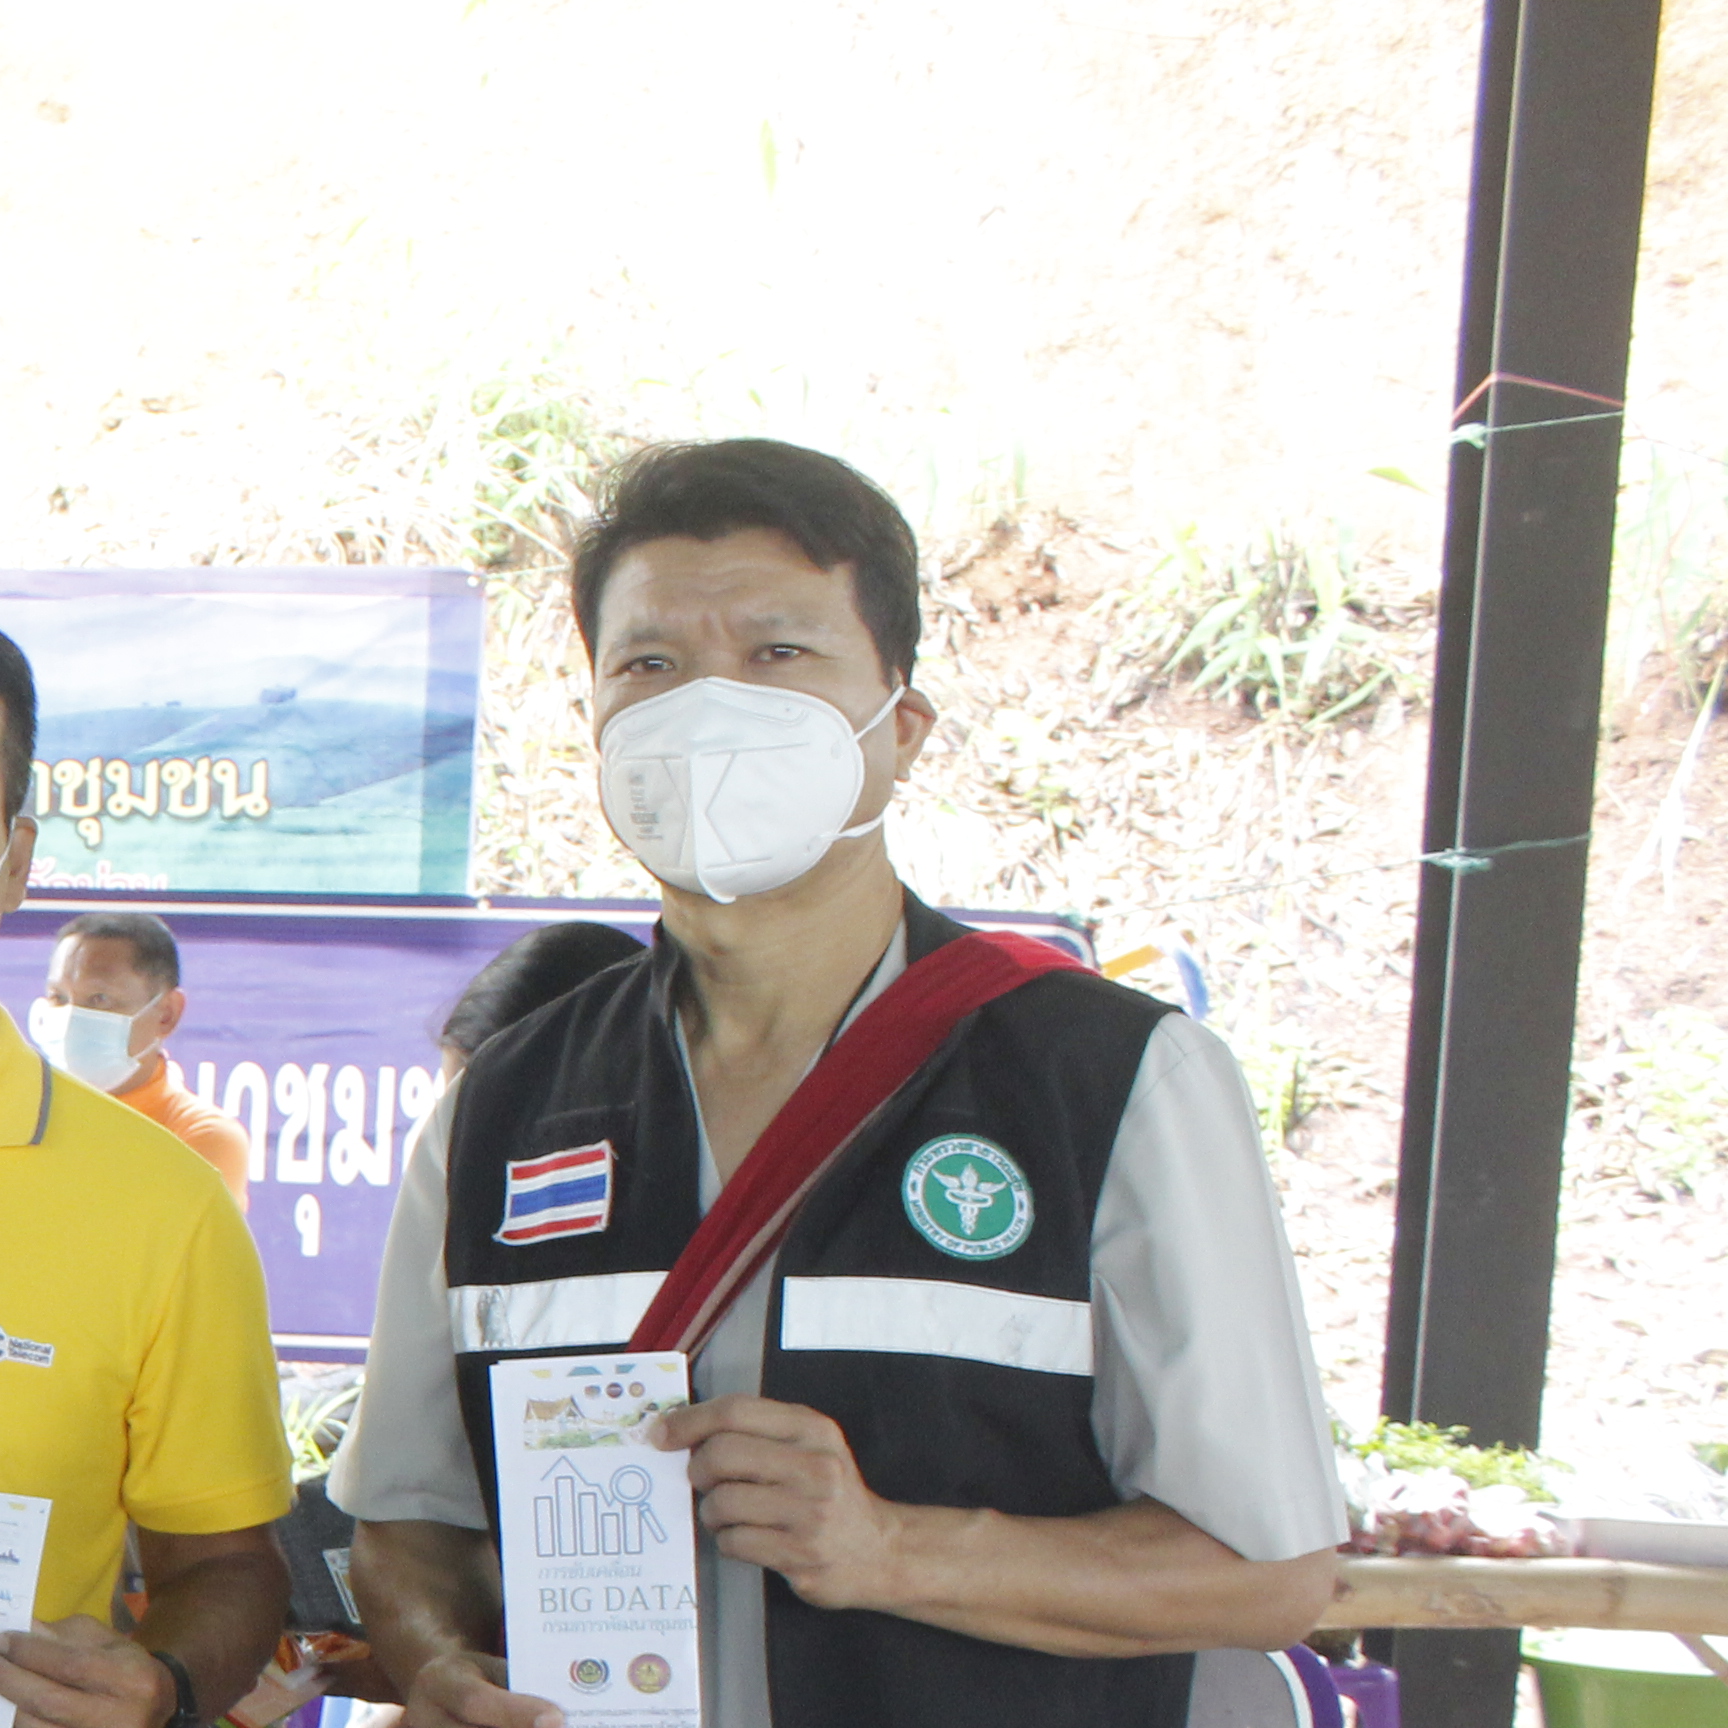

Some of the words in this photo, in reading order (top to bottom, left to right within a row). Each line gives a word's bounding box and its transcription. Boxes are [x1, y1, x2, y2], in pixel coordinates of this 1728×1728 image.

[8, 1338, 52, 1356] National
[538, 1585, 592, 1614] BIG
[603, 1583, 699, 1612] DATA
